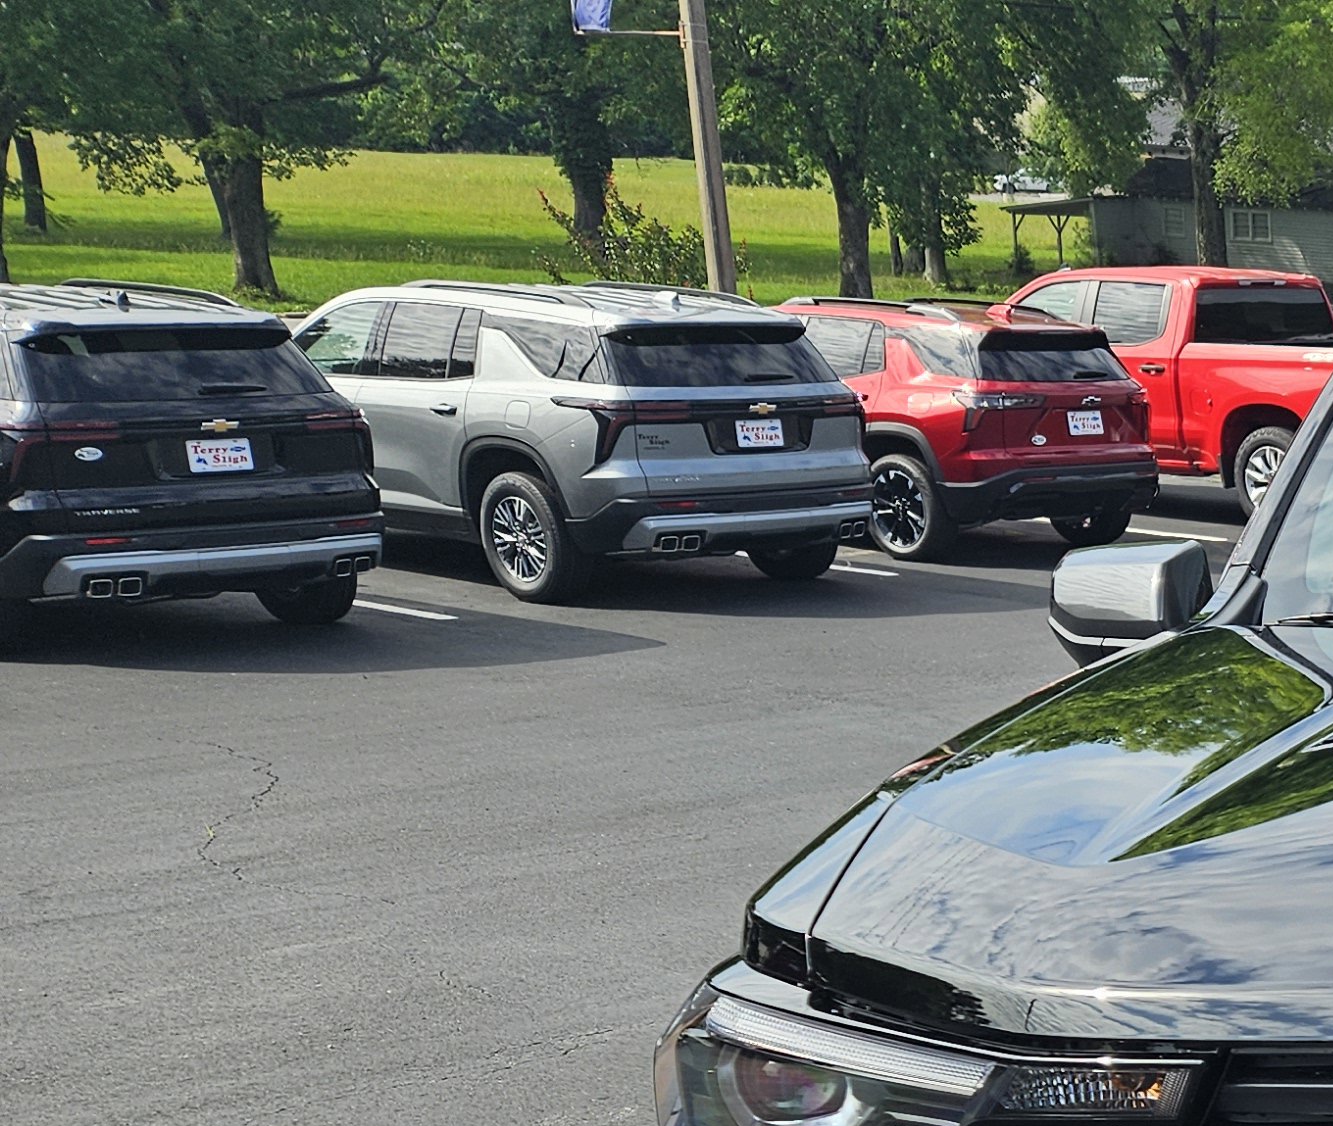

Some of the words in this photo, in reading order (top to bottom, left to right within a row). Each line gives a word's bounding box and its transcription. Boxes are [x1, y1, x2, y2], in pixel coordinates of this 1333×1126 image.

[739, 424, 766, 433] Terry
[754, 432, 781, 442] Sligh
[191, 444, 229, 455] Terry
[212, 454, 248, 465] Sligh
[74, 507, 141, 517] TRAVERSE
